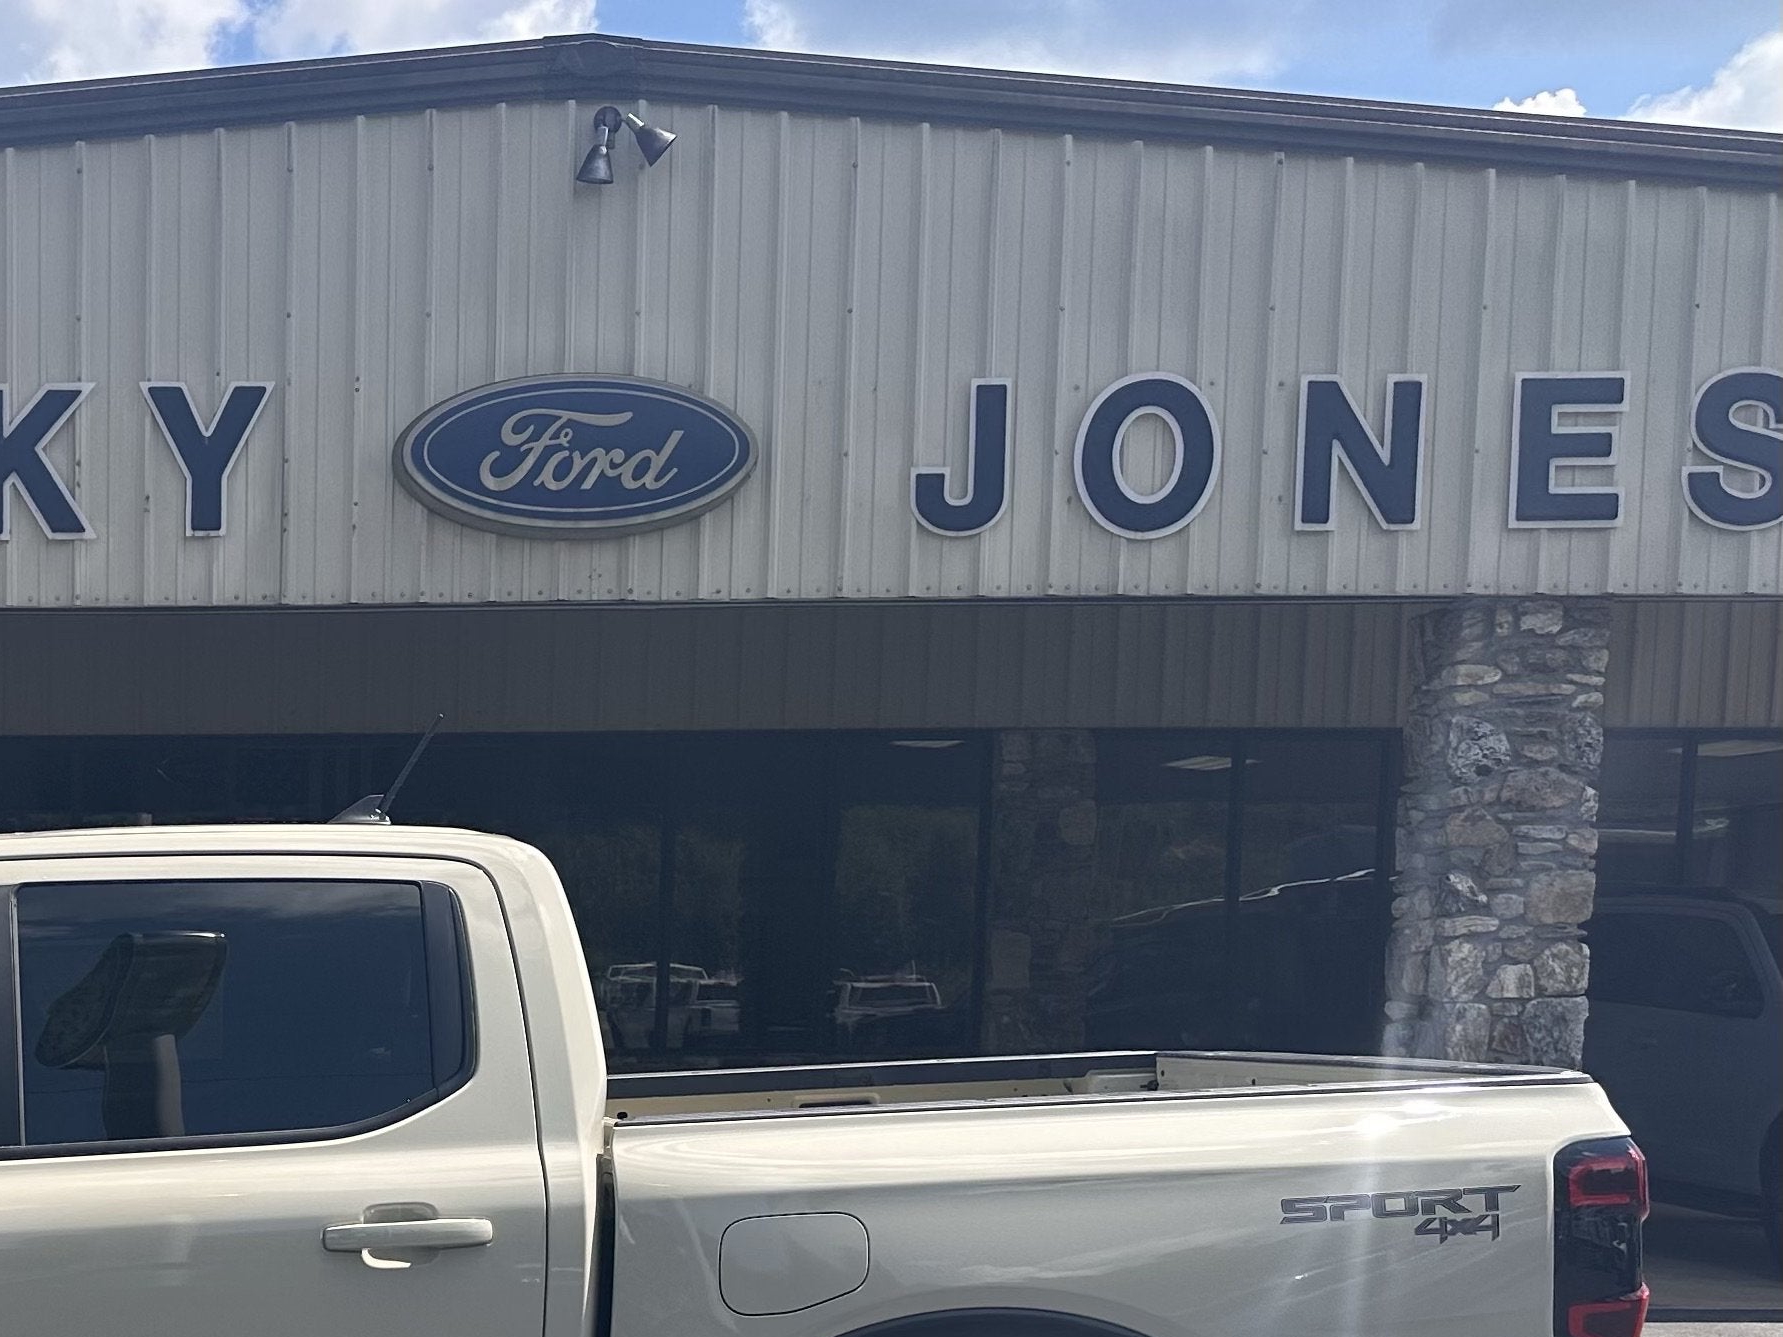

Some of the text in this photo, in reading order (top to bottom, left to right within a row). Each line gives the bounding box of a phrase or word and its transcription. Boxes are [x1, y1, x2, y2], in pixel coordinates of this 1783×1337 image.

[479, 408, 685, 491] Ford
[910, 366, 1783, 540] JONES
[1280, 1184, 1522, 1225] SPORT
